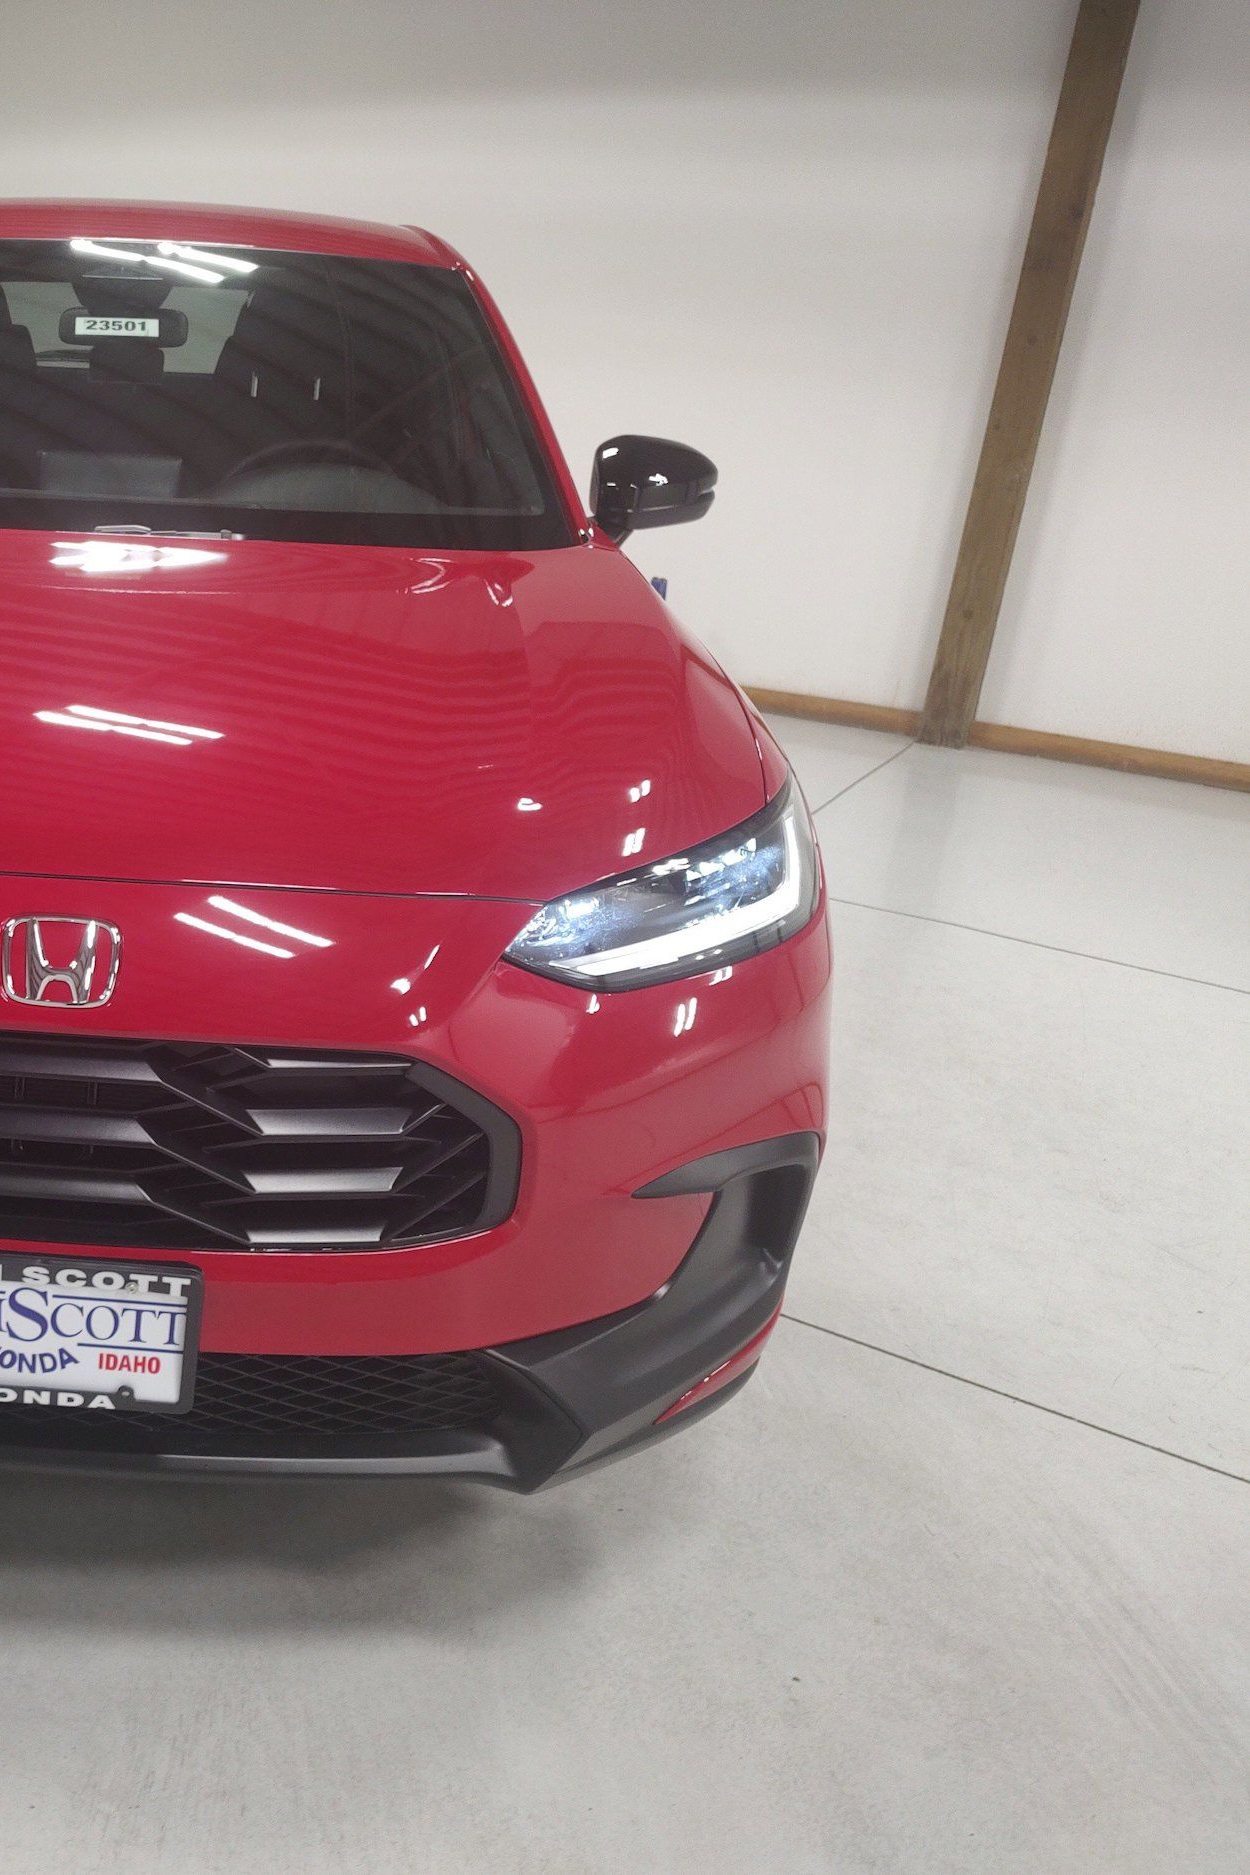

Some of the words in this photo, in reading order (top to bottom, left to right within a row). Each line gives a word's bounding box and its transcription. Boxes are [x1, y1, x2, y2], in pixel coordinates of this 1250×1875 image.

[86, 320, 147, 332] 23501
[22, 1266, 192, 1297] SCOTT
[98, 1353, 161, 1375] IDAHO
